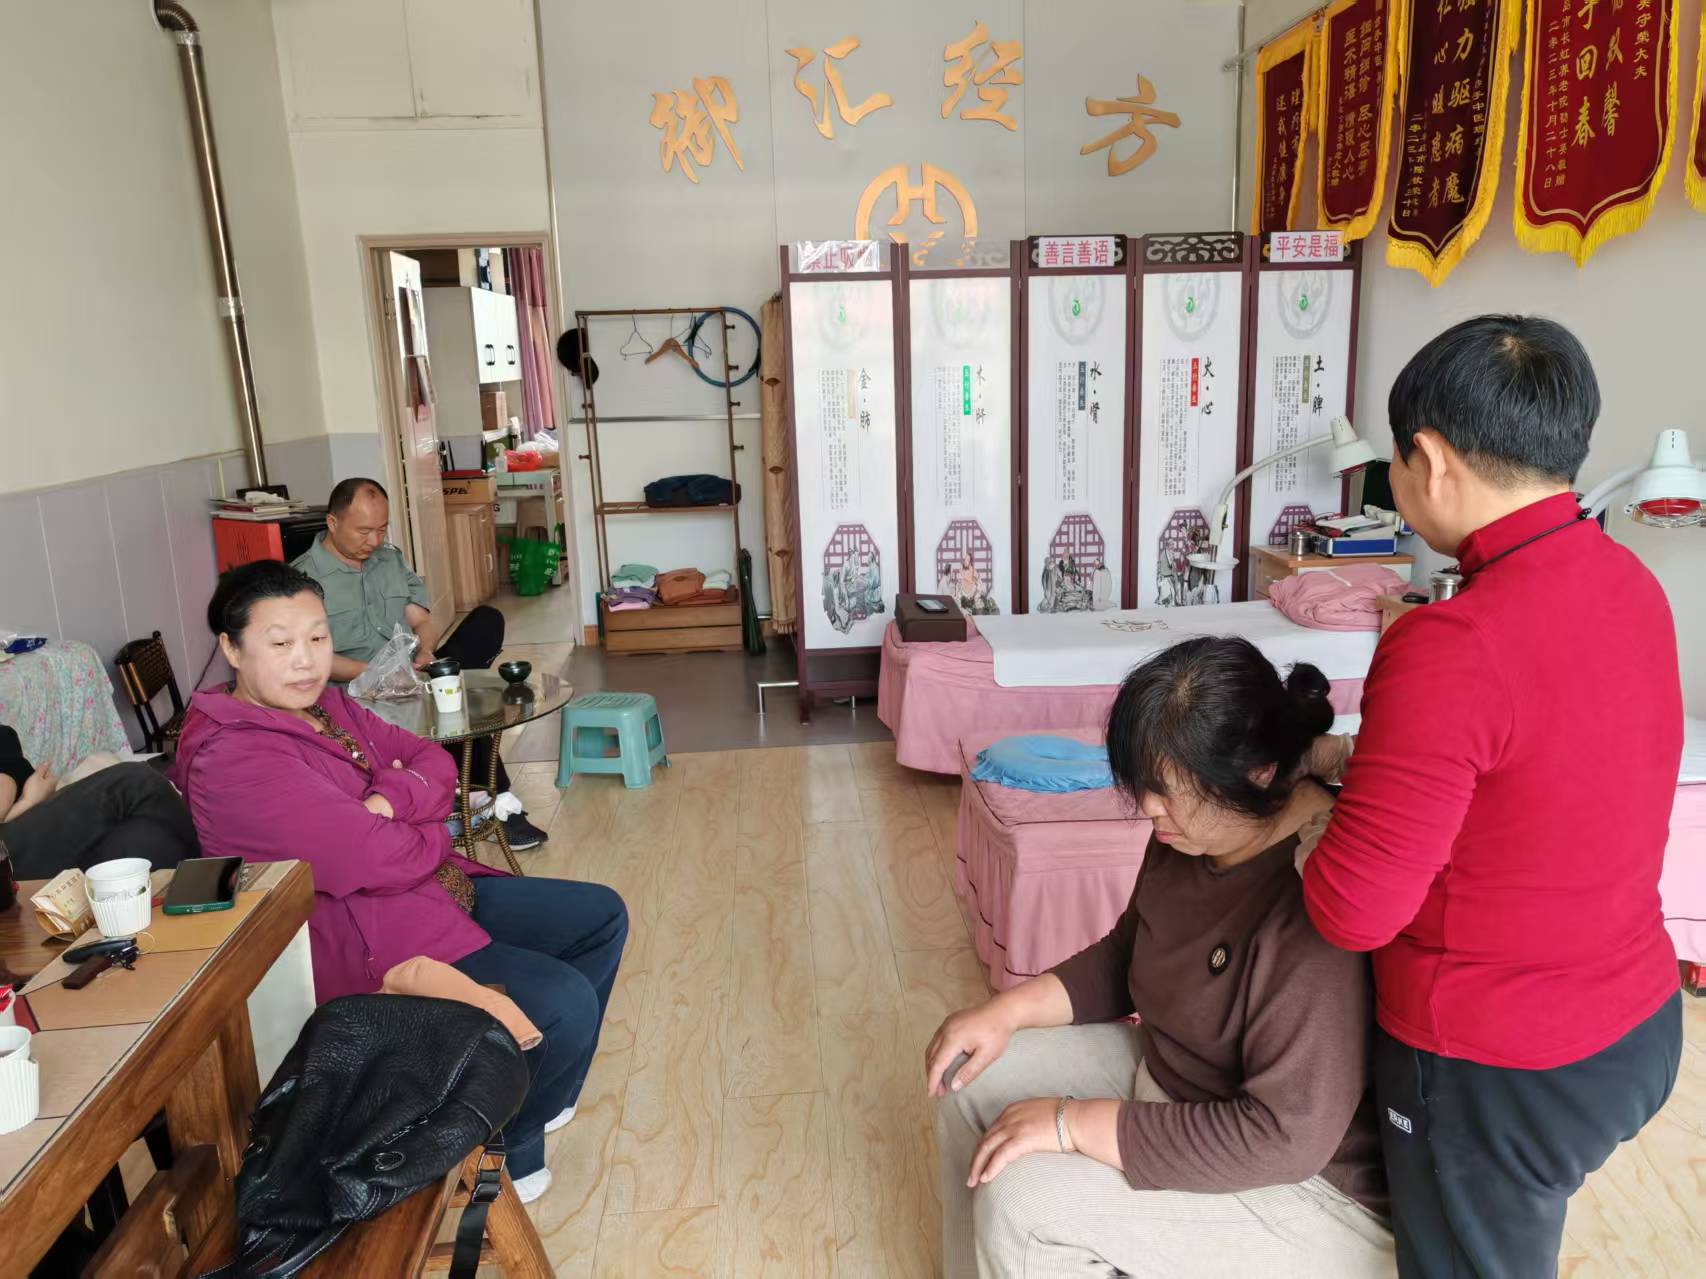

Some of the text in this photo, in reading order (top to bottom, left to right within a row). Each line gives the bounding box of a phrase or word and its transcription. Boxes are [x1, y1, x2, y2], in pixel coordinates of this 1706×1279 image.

[1543, 20, 1560, 189] 二零二三年十月二十八日
[1043, 238, 1110, 267] 善言善语
[1275, 234, 1340, 260] 平安是福
